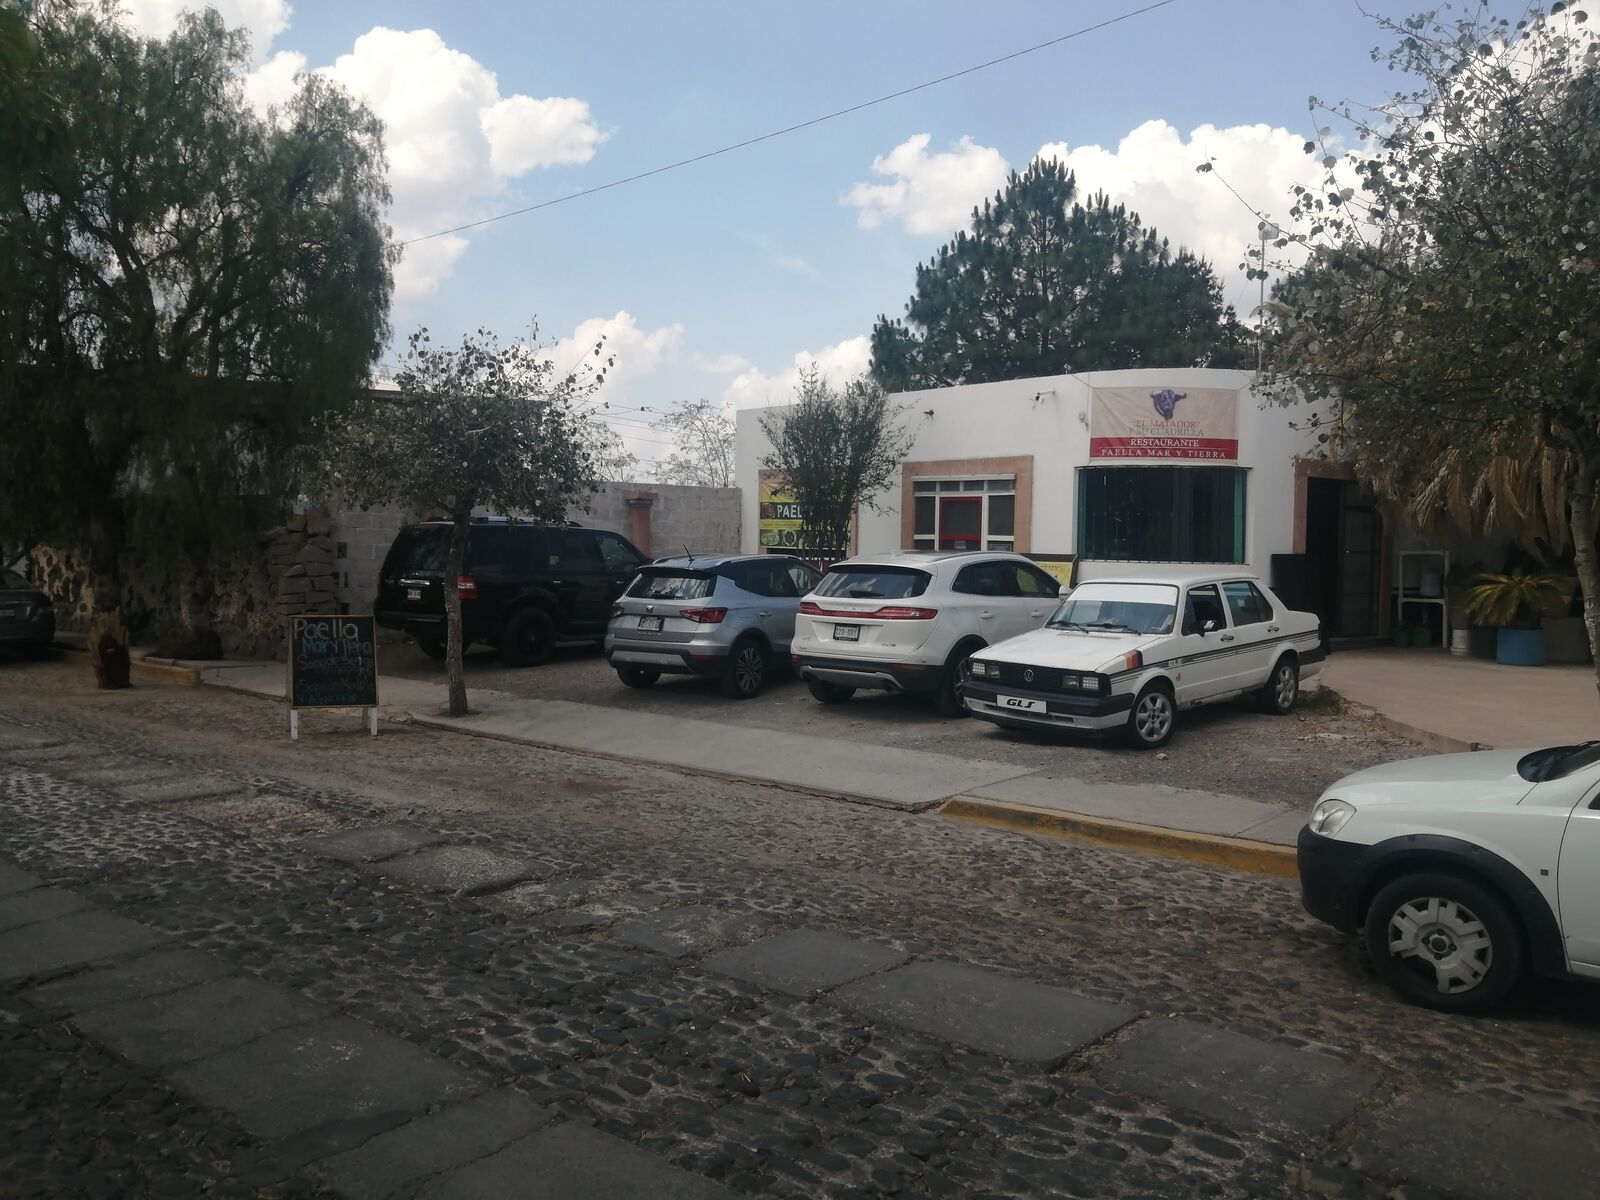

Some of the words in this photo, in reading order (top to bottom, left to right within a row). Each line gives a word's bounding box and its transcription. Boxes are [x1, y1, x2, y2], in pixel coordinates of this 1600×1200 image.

[1150, 428, 1204, 437] CUADRILLA
[1130, 439, 1200, 447] RESTAURANTE
[1147, 449, 1172, 457] MAR
[1188, 450, 1226, 458] TIERRA
[777, 504, 803, 518] PAEL
[293, 618, 360, 641] Paella
[302, 640, 329, 655] Mar
[1006, 698, 1036, 709] GLS
